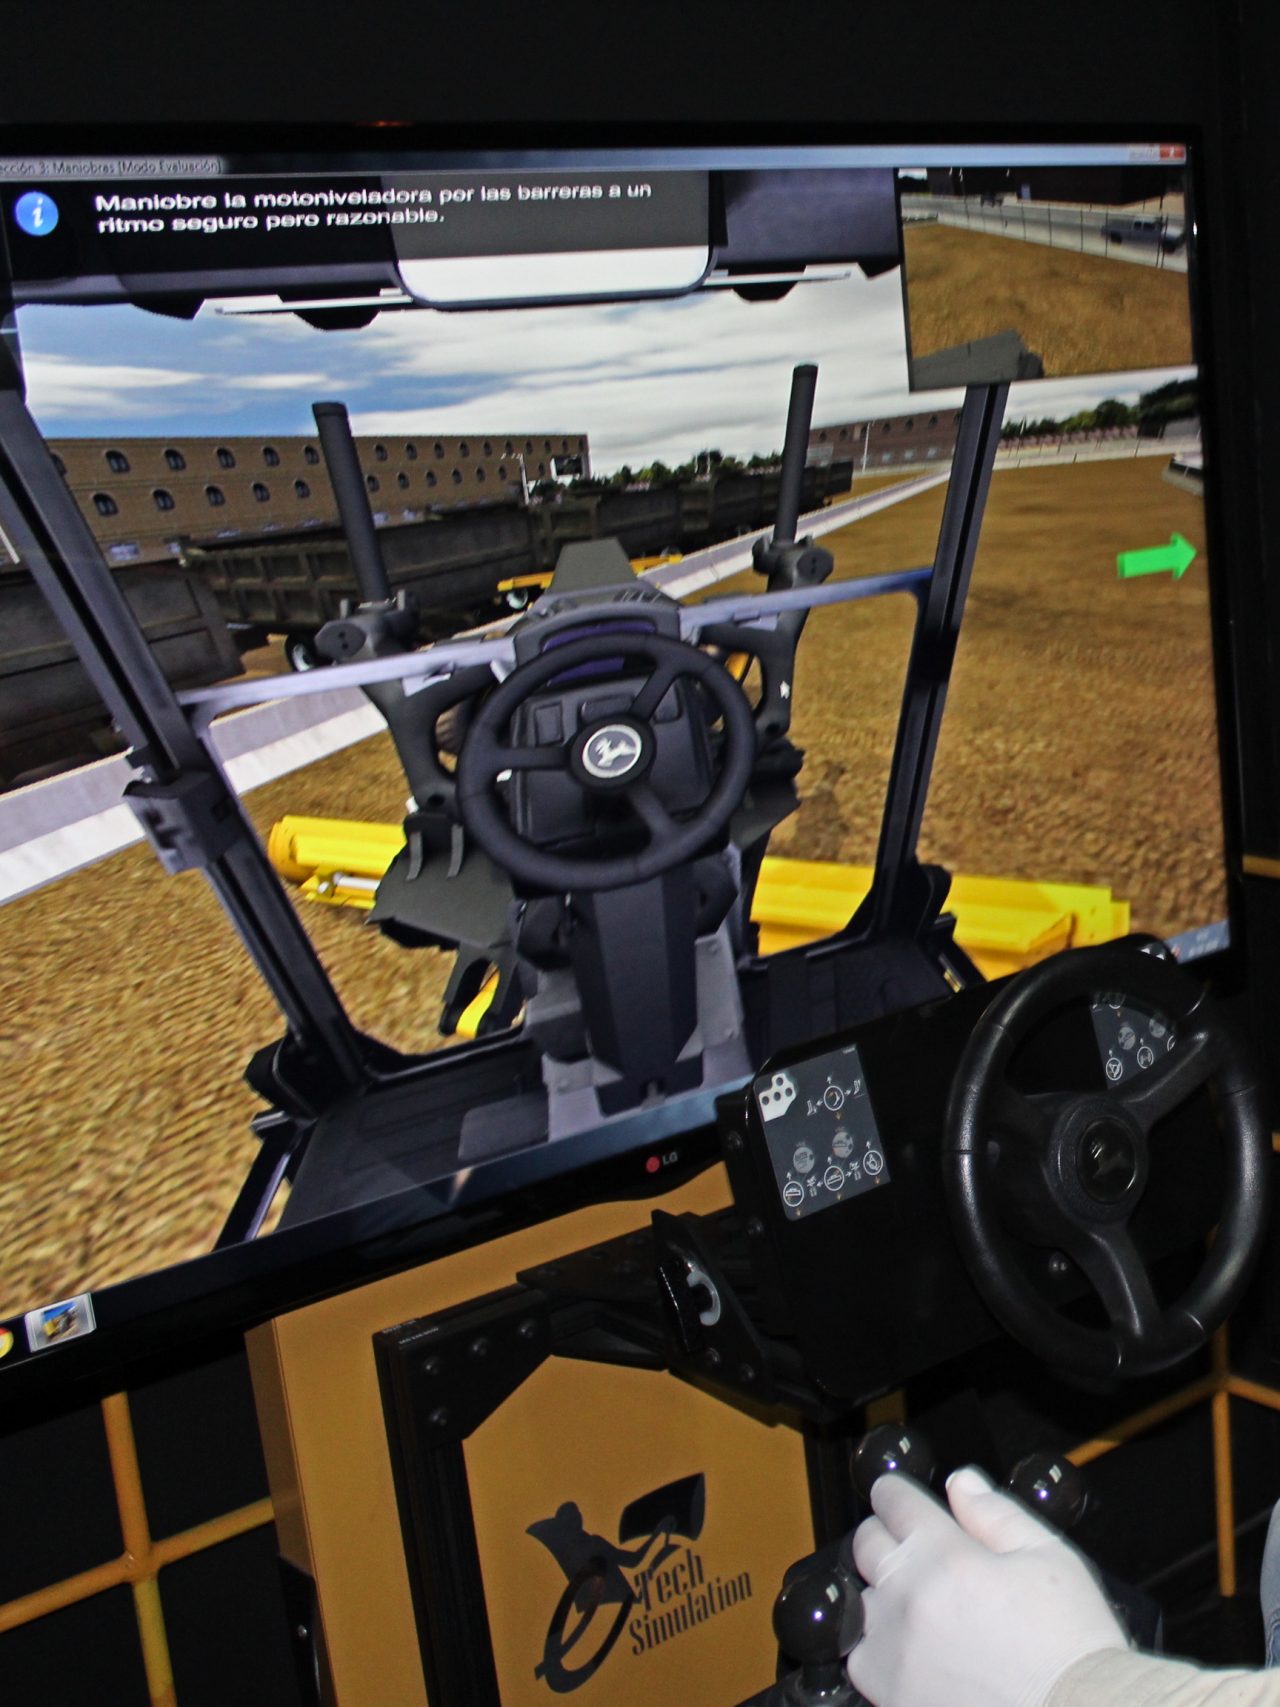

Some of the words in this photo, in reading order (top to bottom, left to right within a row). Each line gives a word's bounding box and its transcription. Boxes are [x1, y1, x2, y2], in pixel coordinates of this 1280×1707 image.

[39, 160, 50, 175] 3:
[53, 160, 115, 175] Maniobras
[95, 193, 217, 212] Maniobre
[224, 192, 246, 208] la
[254, 188, 432, 208] motoniveladora
[439, 188, 475, 206] por
[481, 185, 511, 202] las
[518, 184, 603, 201] barreras
[609, 184, 621, 198] a
[627, 183, 651, 198] un
[98, 217, 165, 234] ritmo
[172, 215, 258, 233] seguro
[266, 213, 320, 232] pero
[326, 207, 445, 226] razonable.
[662, 1151, 678, 1166] LG
[633, 1548, 704, 1612] Tech
[629, 1571, 752, 1656] Simulation
